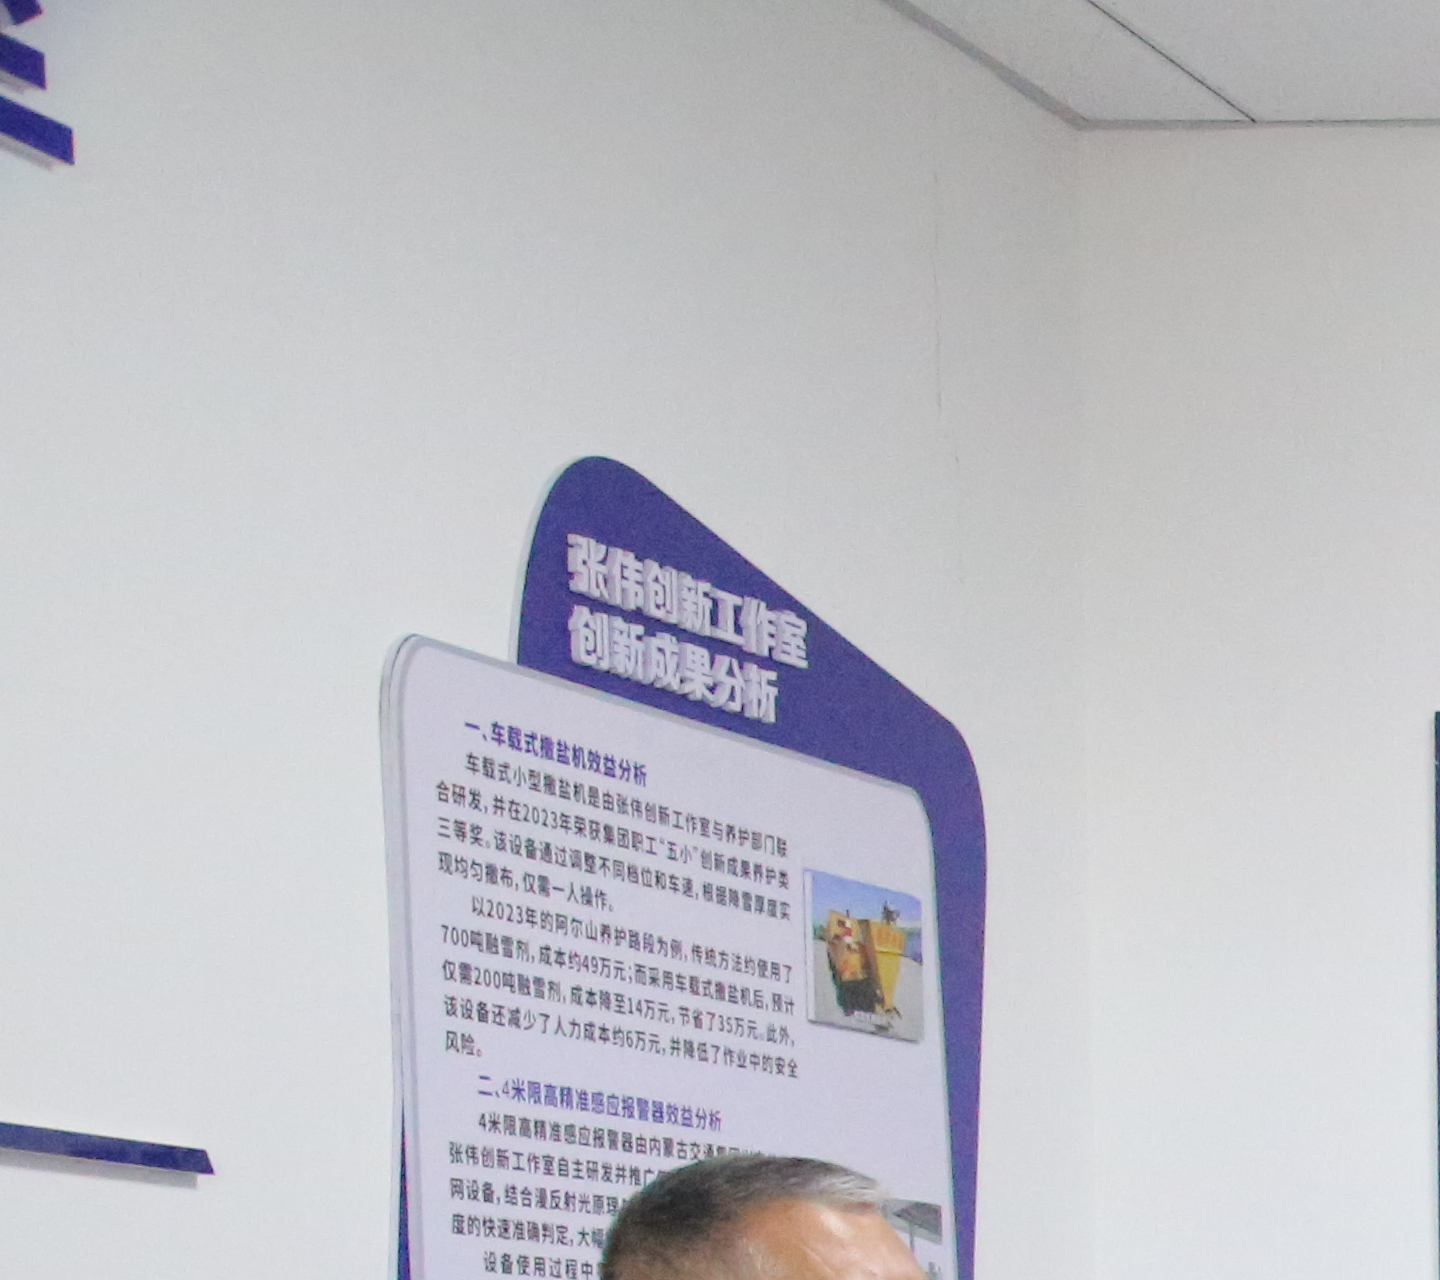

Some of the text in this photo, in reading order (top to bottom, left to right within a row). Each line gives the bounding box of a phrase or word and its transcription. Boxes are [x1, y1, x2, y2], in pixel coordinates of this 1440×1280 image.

[565, 532, 809, 669] 张伟创新工作室
[567, 603, 779, 723] 创新成果分析
[444, 1028, 483, 1058] 风险。
